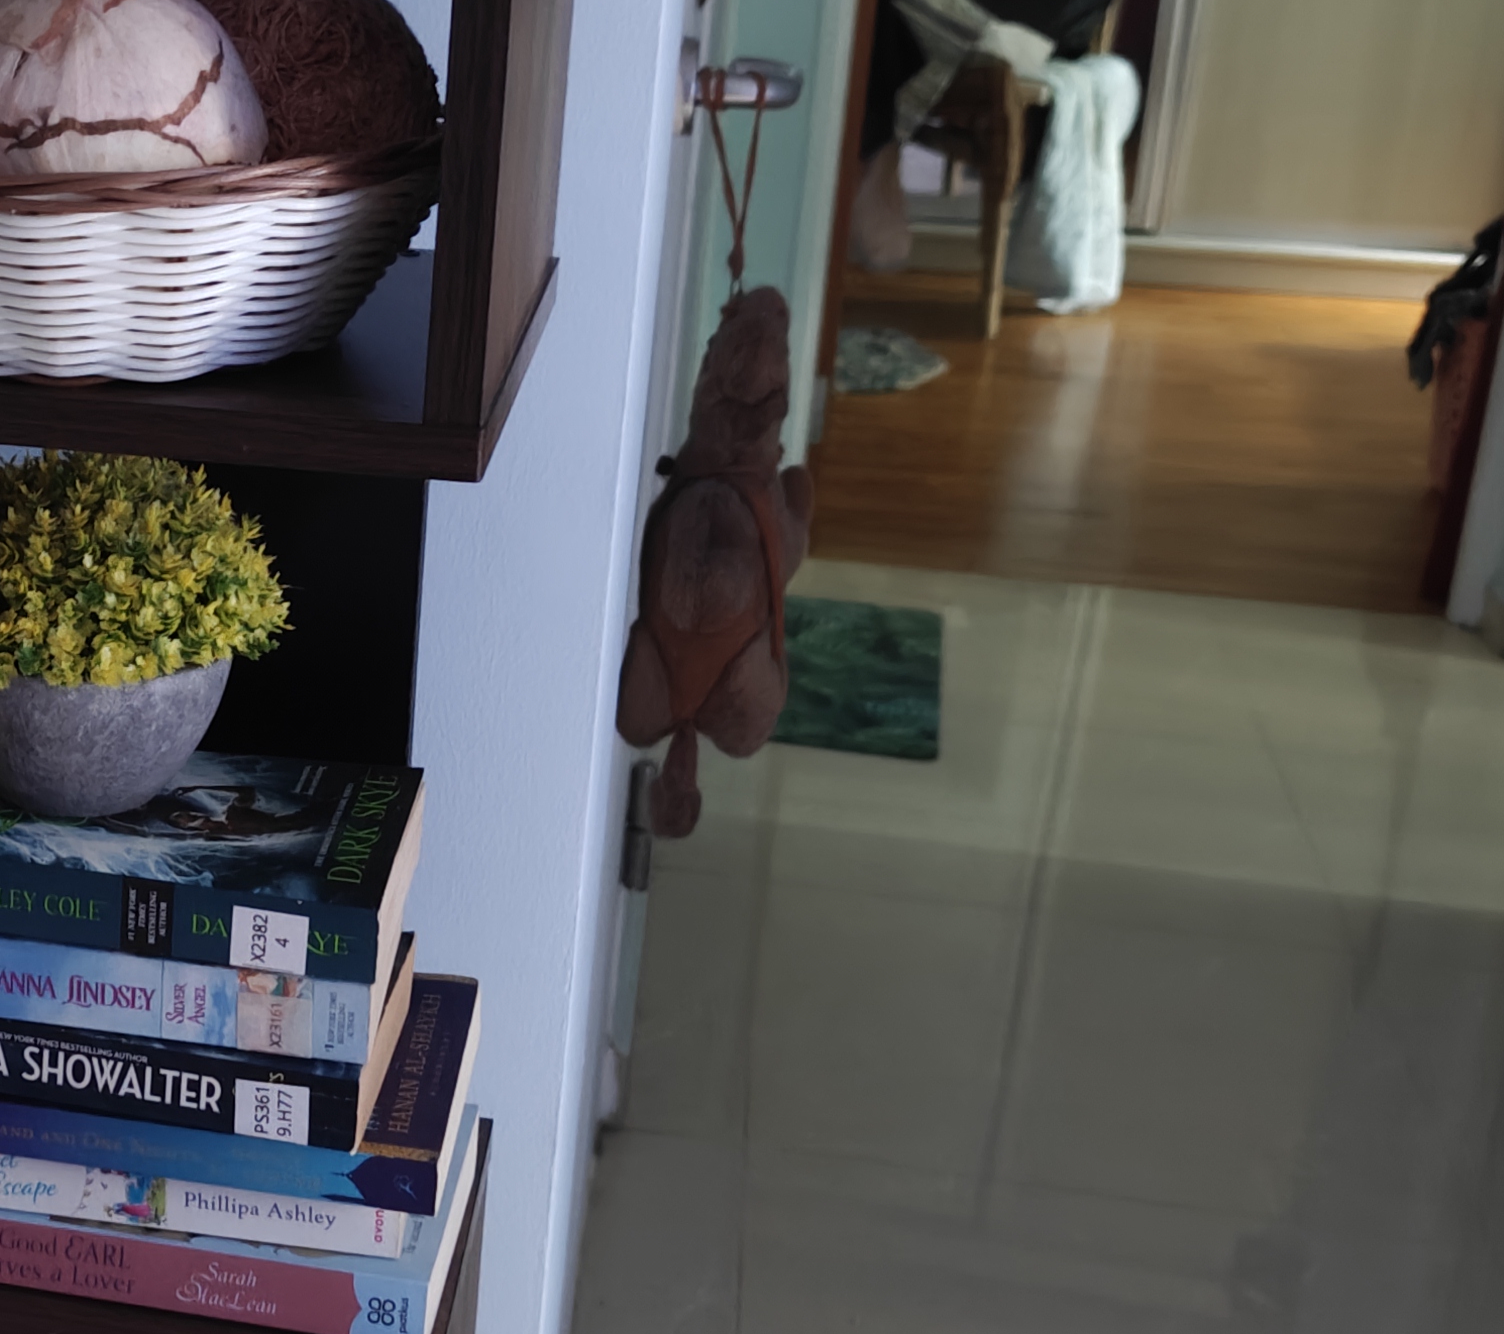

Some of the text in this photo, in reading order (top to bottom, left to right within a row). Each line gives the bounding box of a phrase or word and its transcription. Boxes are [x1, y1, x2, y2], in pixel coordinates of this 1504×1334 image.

[350, 767, 402, 820] SKYE
[326, 824, 382, 885] DARK
[43, 893, 103, 922] COLE
[250, 913, 290, 964] X2382 4
[61, 974, 157, 1013] LINDSEY
[164, 982, 188, 1025] SILVER
[187, 984, 207, 1026] ANGEL
[268, 1002, 284, 1049] X23161
[13, 1033, 36, 1044] YORK
[37, 1036, 59, 1048] TIMES
[60, 1040, 113, 1058] BESTSELLING
[113, 1051, 149, 1065] AUTHOR
[22, 1045, 223, 1114] SHOWALTER
[254, 1086, 294, 1138] PS361 9.H77
[388, 1076, 422, 1135] HANAN
[184, 1191, 336, 1230] Phillipa Ashley
[374, 1208, 384, 1243] avon
[0, 1224, 57, 1258] Good
[64, 1233, 133, 1269] EARL
[51, 1271, 62, 1283] a
[72, 1264, 138, 1295] Lover
[191, 1261, 258, 1288] Sarah
[176, 1282, 278, 1317] MacLean
